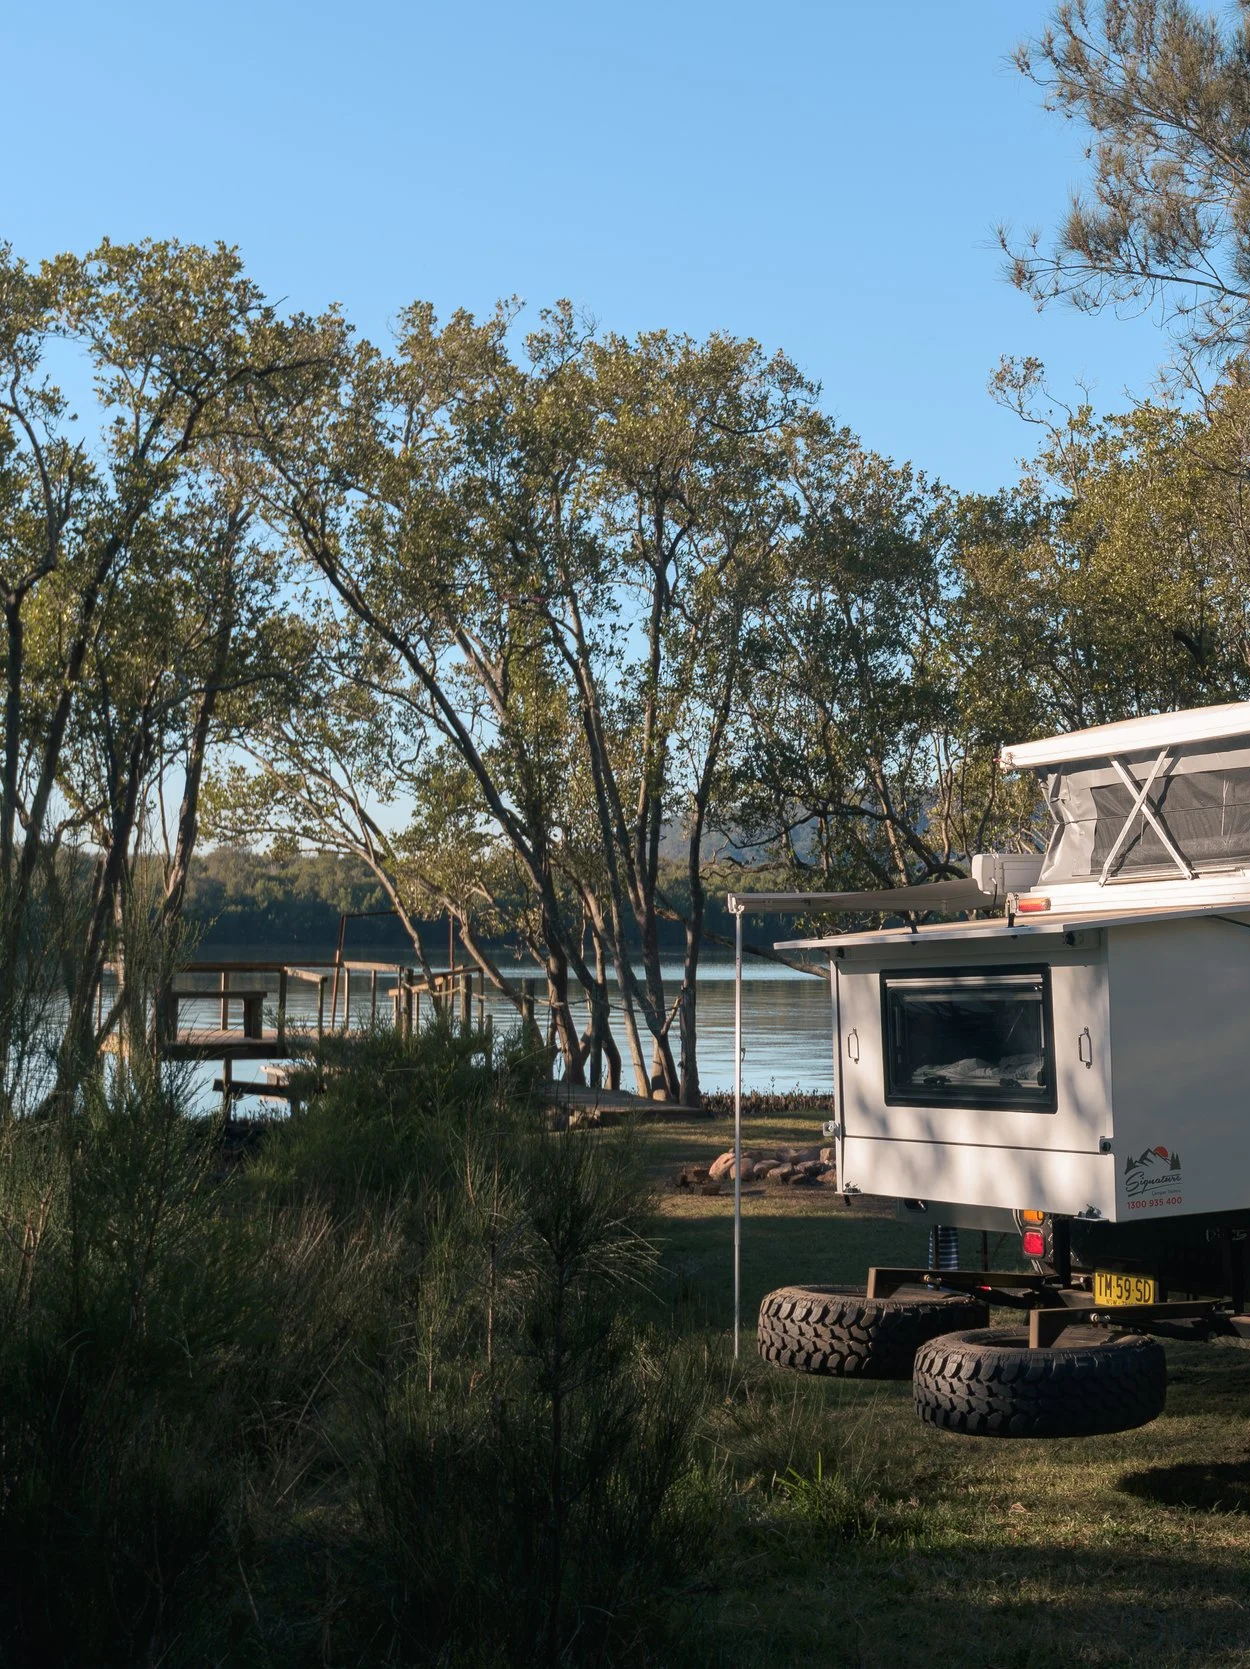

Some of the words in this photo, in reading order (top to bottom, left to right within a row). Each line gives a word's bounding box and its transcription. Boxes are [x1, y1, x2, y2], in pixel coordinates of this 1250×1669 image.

[1125, 1171, 1182, 1195] Signature
[1127, 1200, 1147, 1210] 1300
[1148, 1199, 1164, 1207] 935
[1166, 1196, 1183, 1205] 400
